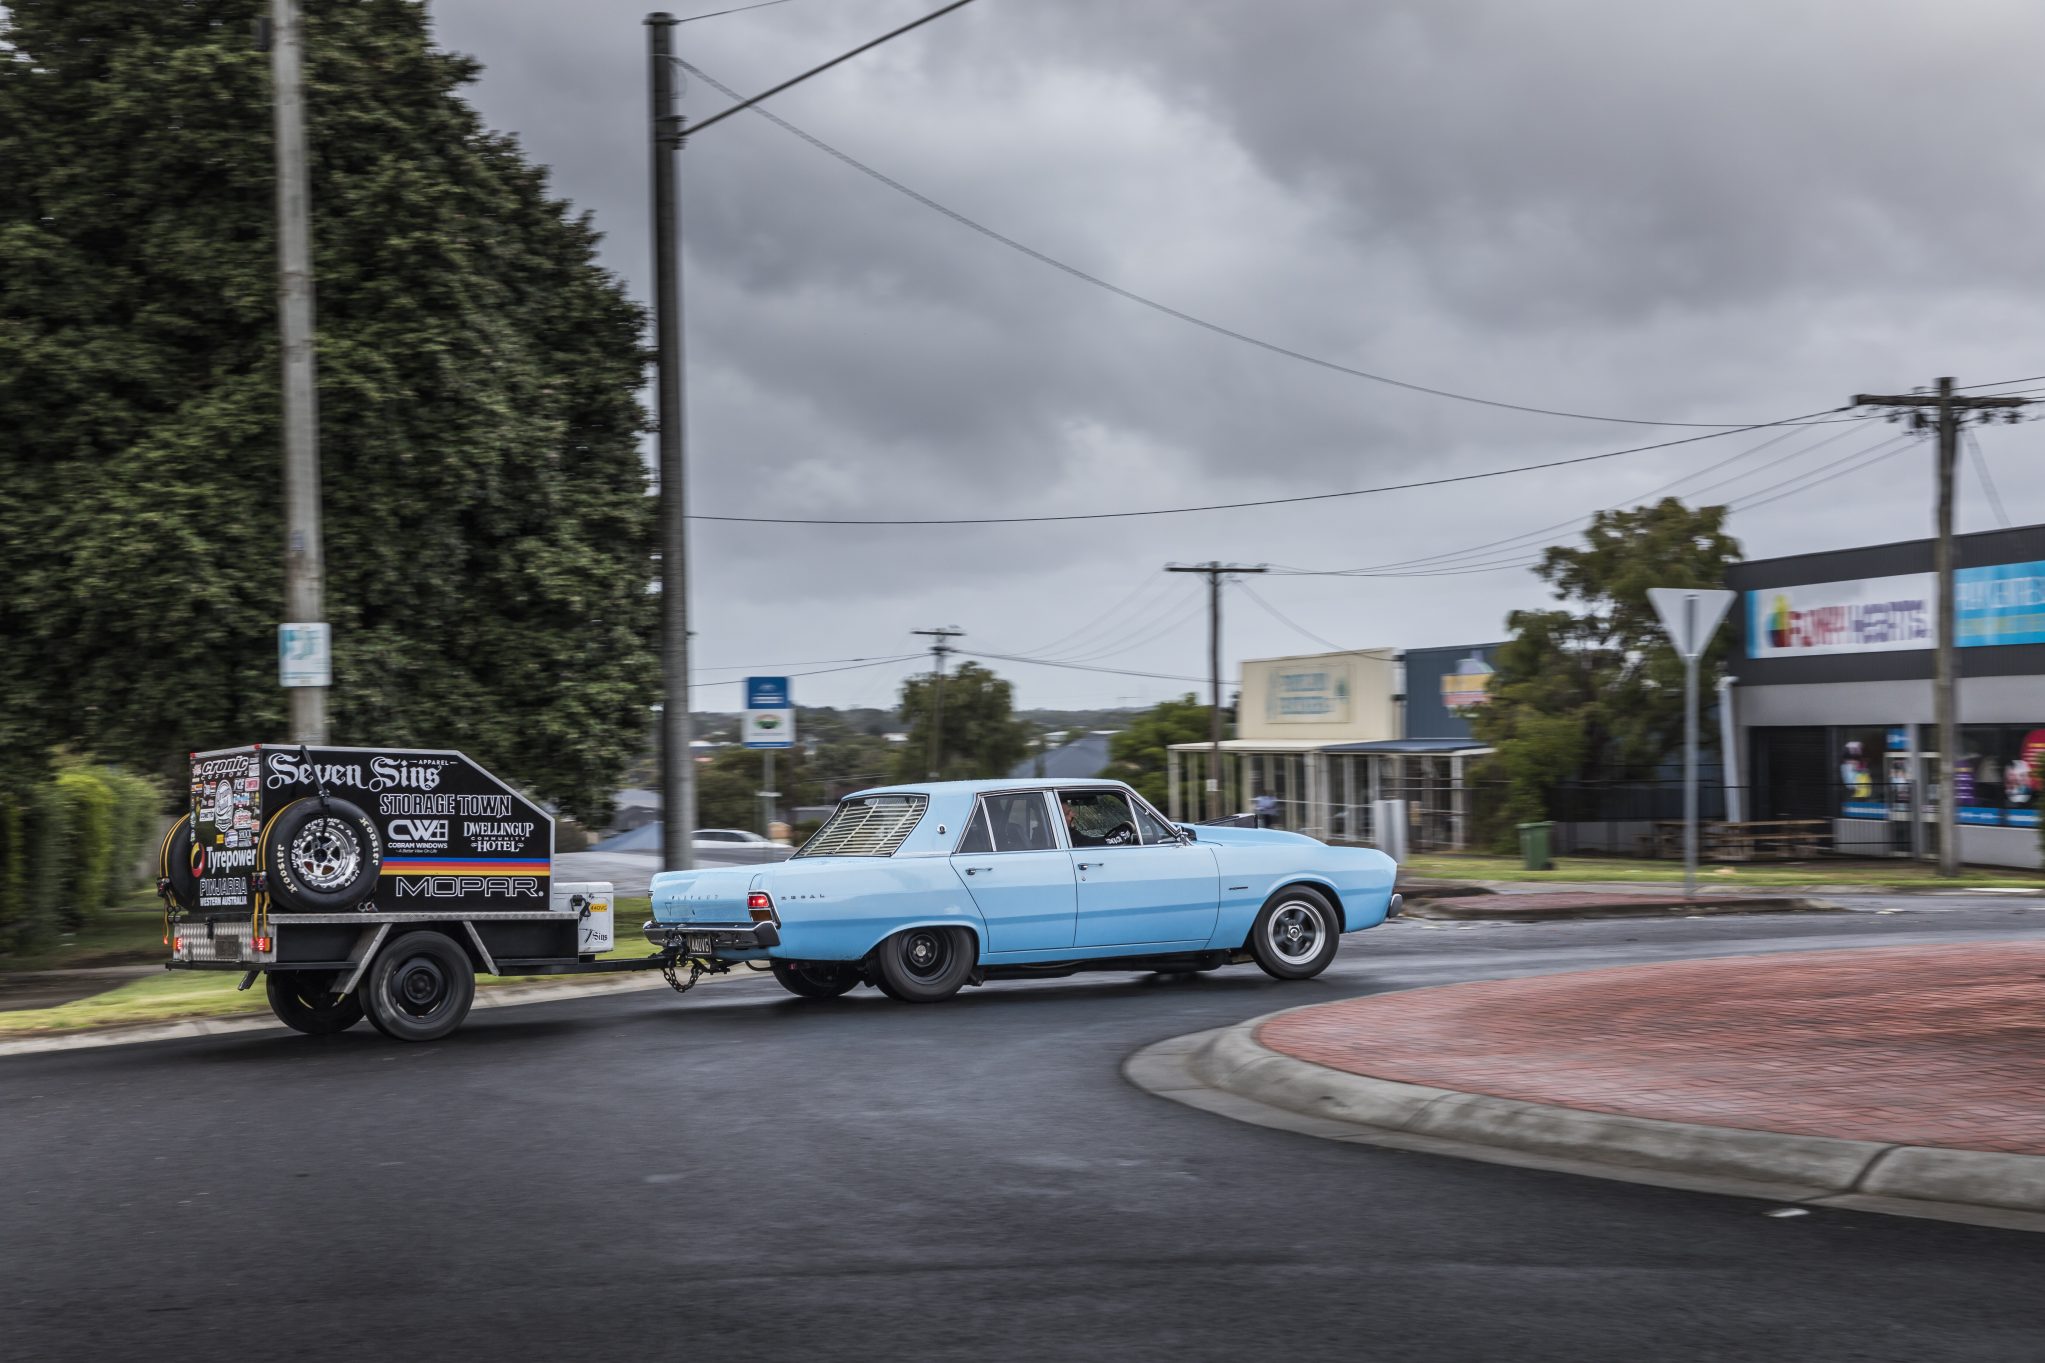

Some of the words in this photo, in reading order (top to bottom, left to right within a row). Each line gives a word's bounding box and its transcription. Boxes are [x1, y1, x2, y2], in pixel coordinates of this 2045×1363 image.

[202, 756, 249, 775] cronic
[266, 752, 368, 789] Seven
[369, 756, 442, 792] Sins
[201, 770, 249, 781] CUSTOMS
[380, 793, 455, 815] STORAGE
[457, 795, 512, 818] TOWN
[305, 817, 341, 830] RACNG
[463, 821, 534, 838] DWELLINGUP
[477, 841, 520, 852] HOTEL
[206, 846, 256, 874] Tyrepower
[200, 877, 247, 896] PINJARRA
[396, 877, 538, 897] MOPAR
[200, 897, 221, 907] WESTERN
[221, 896, 247, 906] AUSTRALIA
[592, 931, 608, 942] Sins
